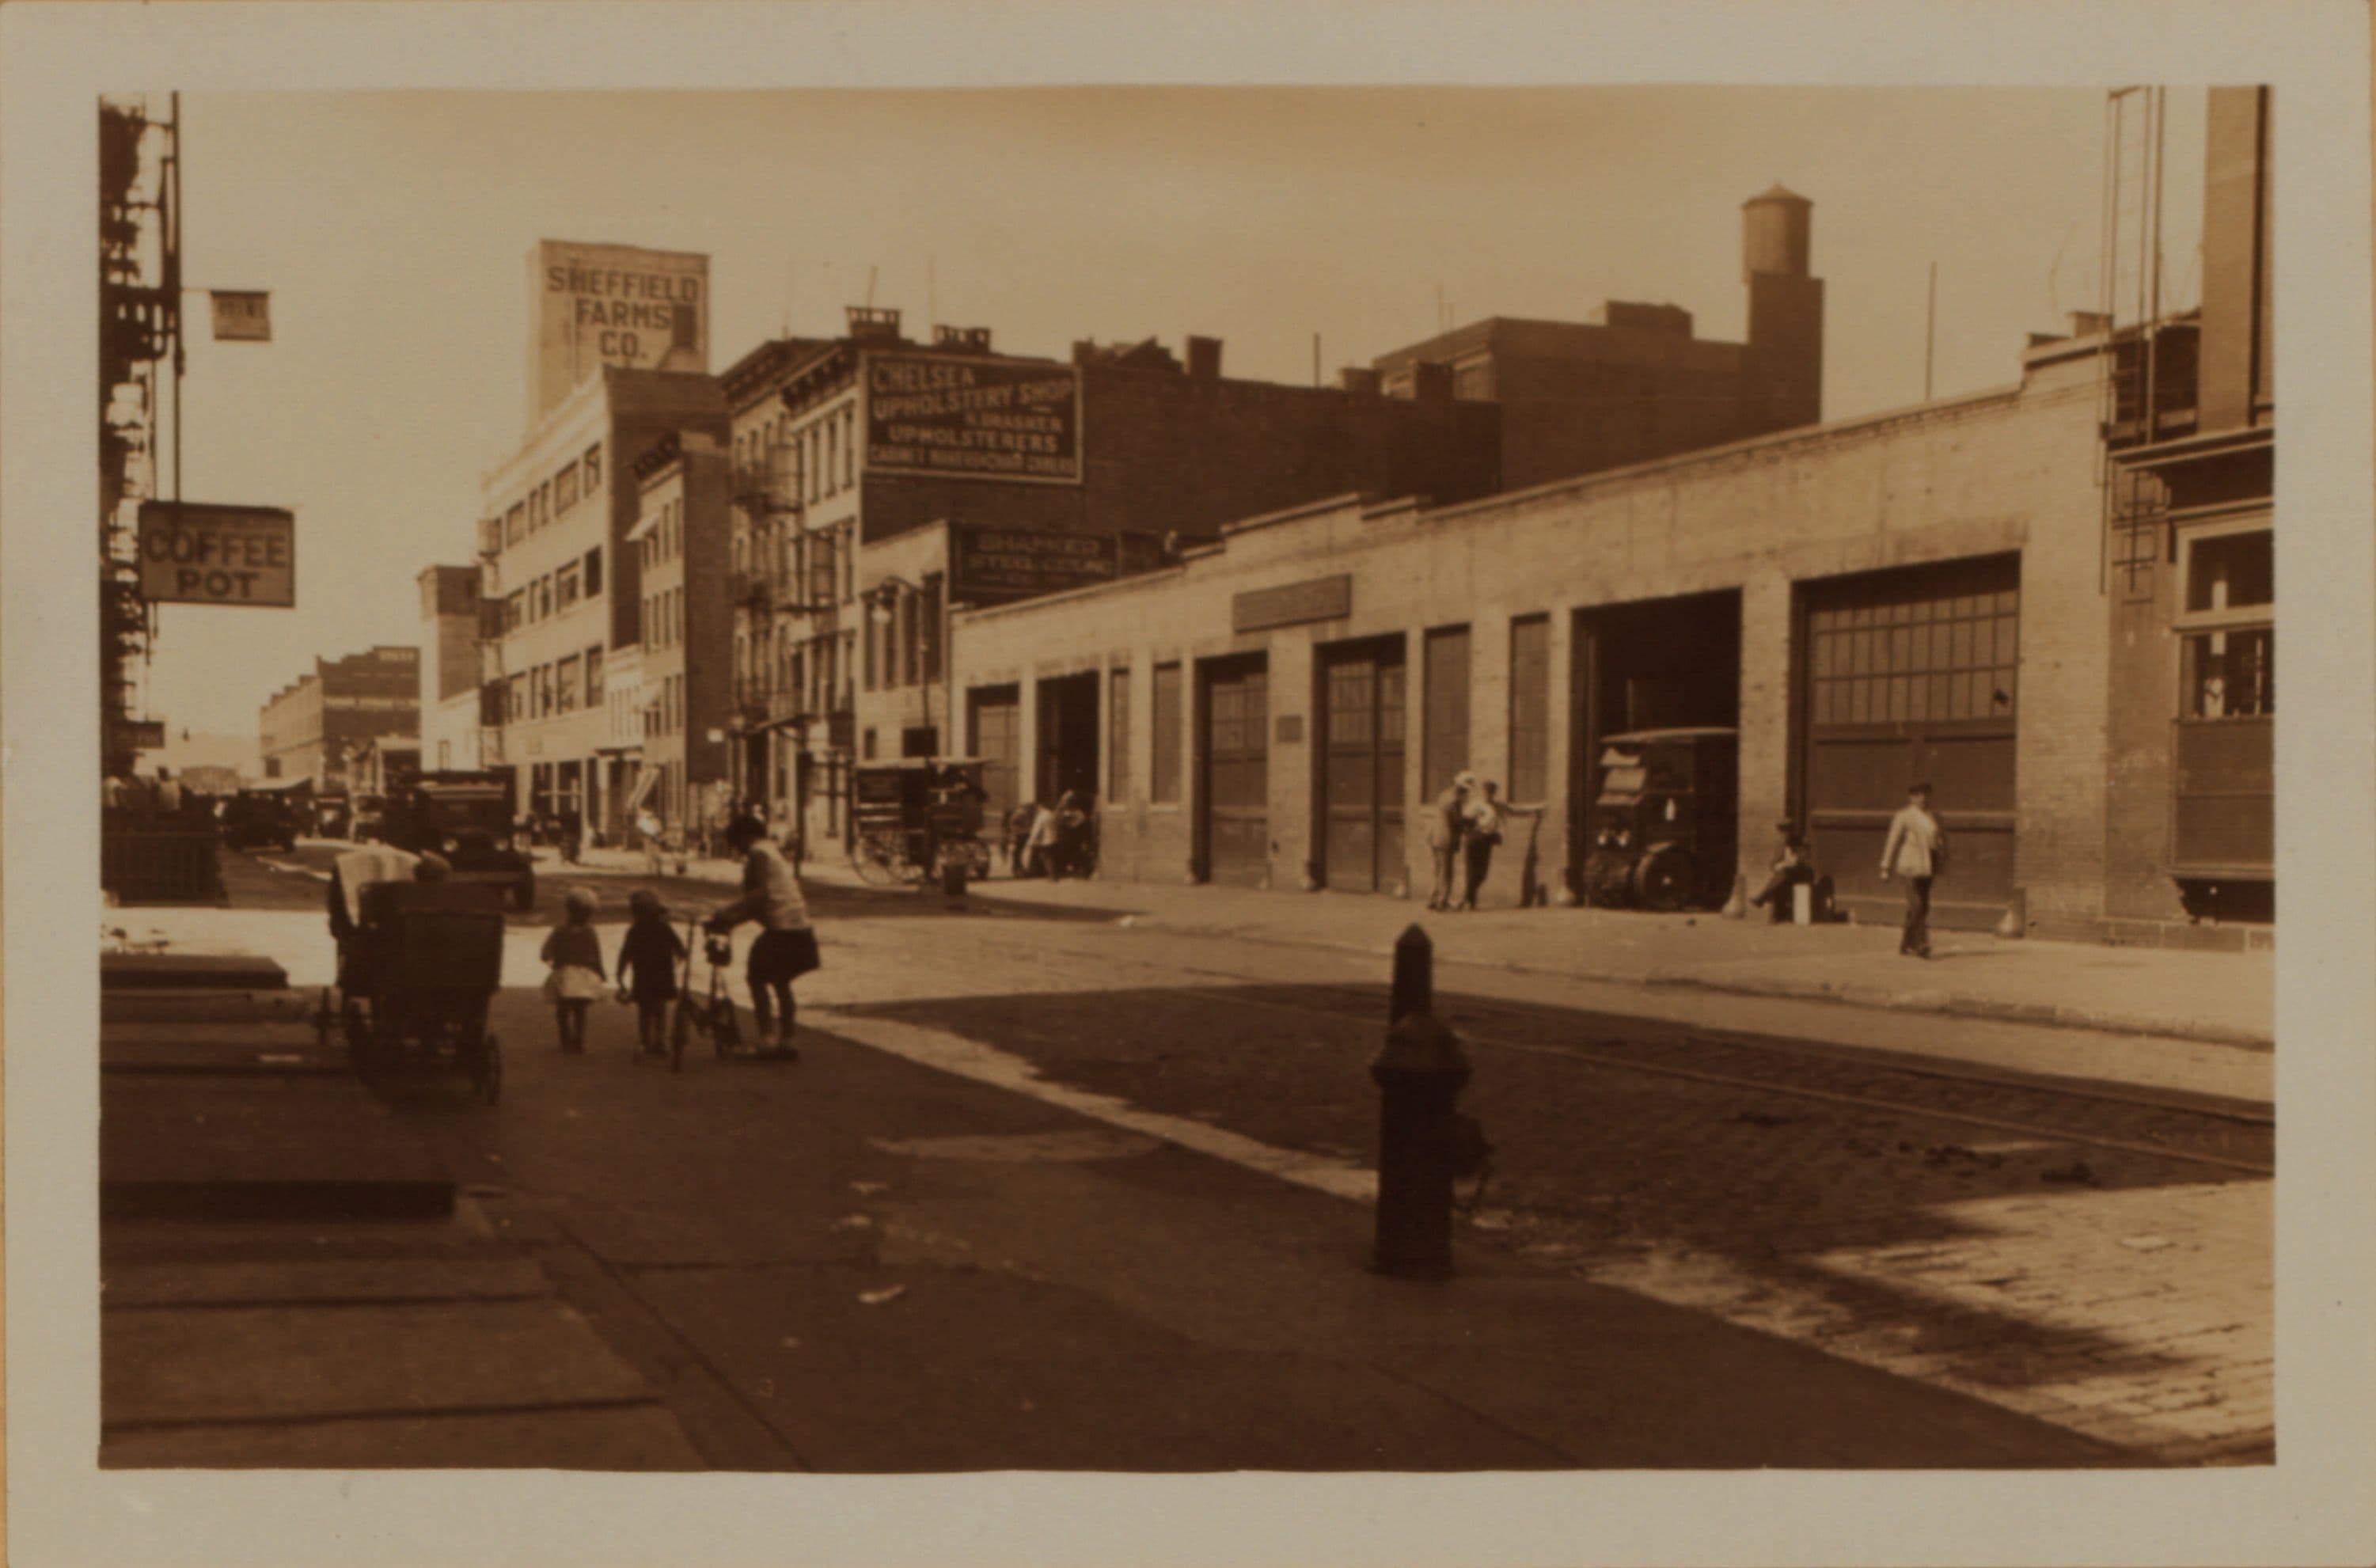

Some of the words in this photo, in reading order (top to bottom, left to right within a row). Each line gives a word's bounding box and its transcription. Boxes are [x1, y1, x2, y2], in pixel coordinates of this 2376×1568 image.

[547, 266, 698, 302] SHEFFIELD
[575, 298, 672, 328] FARMS
[600, 331, 648, 357] CO.
[871, 361, 976, 393] CHELSEA
[872, 385, 1012, 420] UPHOLSTERY
[1019, 378, 1073, 404] SHOP
[889, 423, 1058, 453] UPHOLSTERERS
[145, 529, 286, 568] COFFEE
[177, 568, 260, 598] POT
